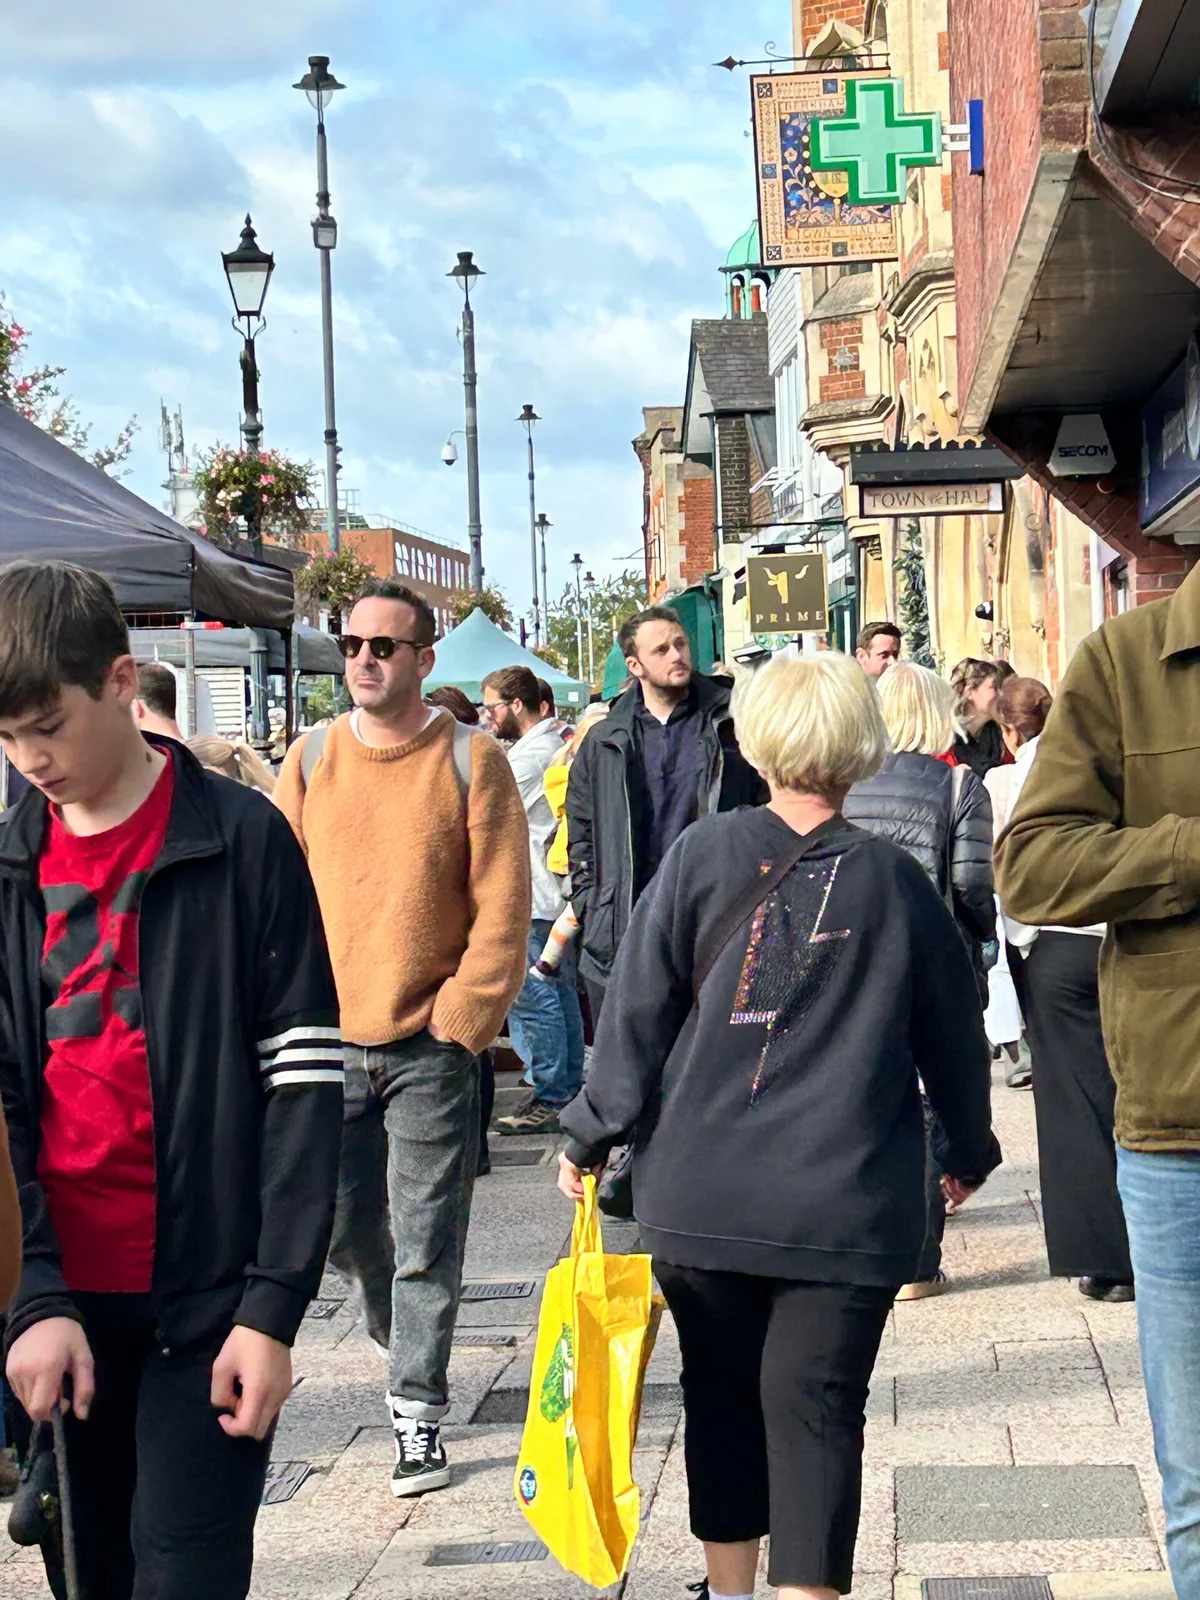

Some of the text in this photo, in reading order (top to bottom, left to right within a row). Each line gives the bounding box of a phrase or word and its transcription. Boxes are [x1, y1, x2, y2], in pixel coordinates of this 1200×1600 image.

[1059, 444, 1109, 458] SECOM
[870, 490, 926, 509] TOWN
[755, 610, 824, 624] PRIME
